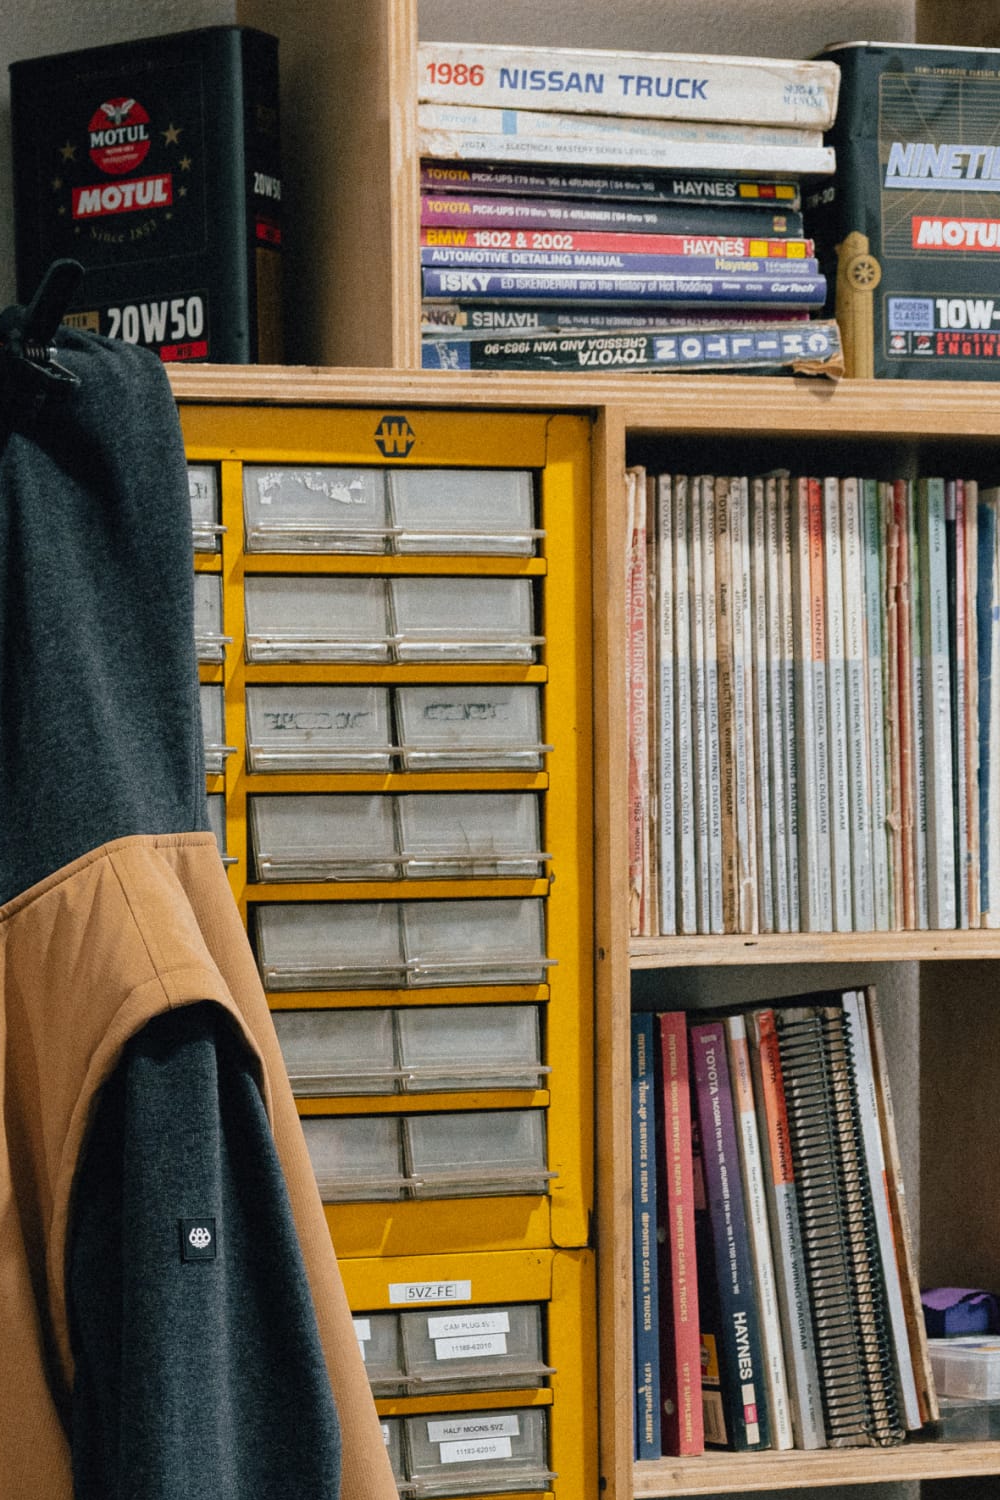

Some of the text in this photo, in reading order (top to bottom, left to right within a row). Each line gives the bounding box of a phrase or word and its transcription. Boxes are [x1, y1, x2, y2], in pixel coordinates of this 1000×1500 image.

[426, 63, 709, 100] 1986 NISSAN TRUCK
[90, 124, 149, 148] MOTUL
[427, 168, 470, 181] TOYOTA
[77, 177, 168, 215] MOTUL
[673, 180, 737, 197] HAYNES
[428, 201, 471, 215] TOYOTA
[426, 230, 573, 250] BMW & 2002
[683, 239, 744, 256] HAYNES
[432, 250, 624, 267] AUTOMOTIVE DETAILING MANUAL
[715, 258, 759, 273] Haynes
[440, 273, 713, 295] ISKY ED ISKENDERIAN and the History of Hot Rodding
[107, 296, 204, 345] 20W50
[472, 312, 539, 328] HAYNES
[534, 338, 584, 352] AND VAN
[578, 349, 648, 367] TOYOTA
[662, 665, 674, 835] ELECTRICAL WIRING DIAGRAM
[704, 1047, 719, 1094] TOYOTA
[676, 1205, 687, 1276] IMPORTED CARS
[408, 1286, 454, 1298] 5VZ-FE
[733, 1311, 753, 1380] HAYNES
